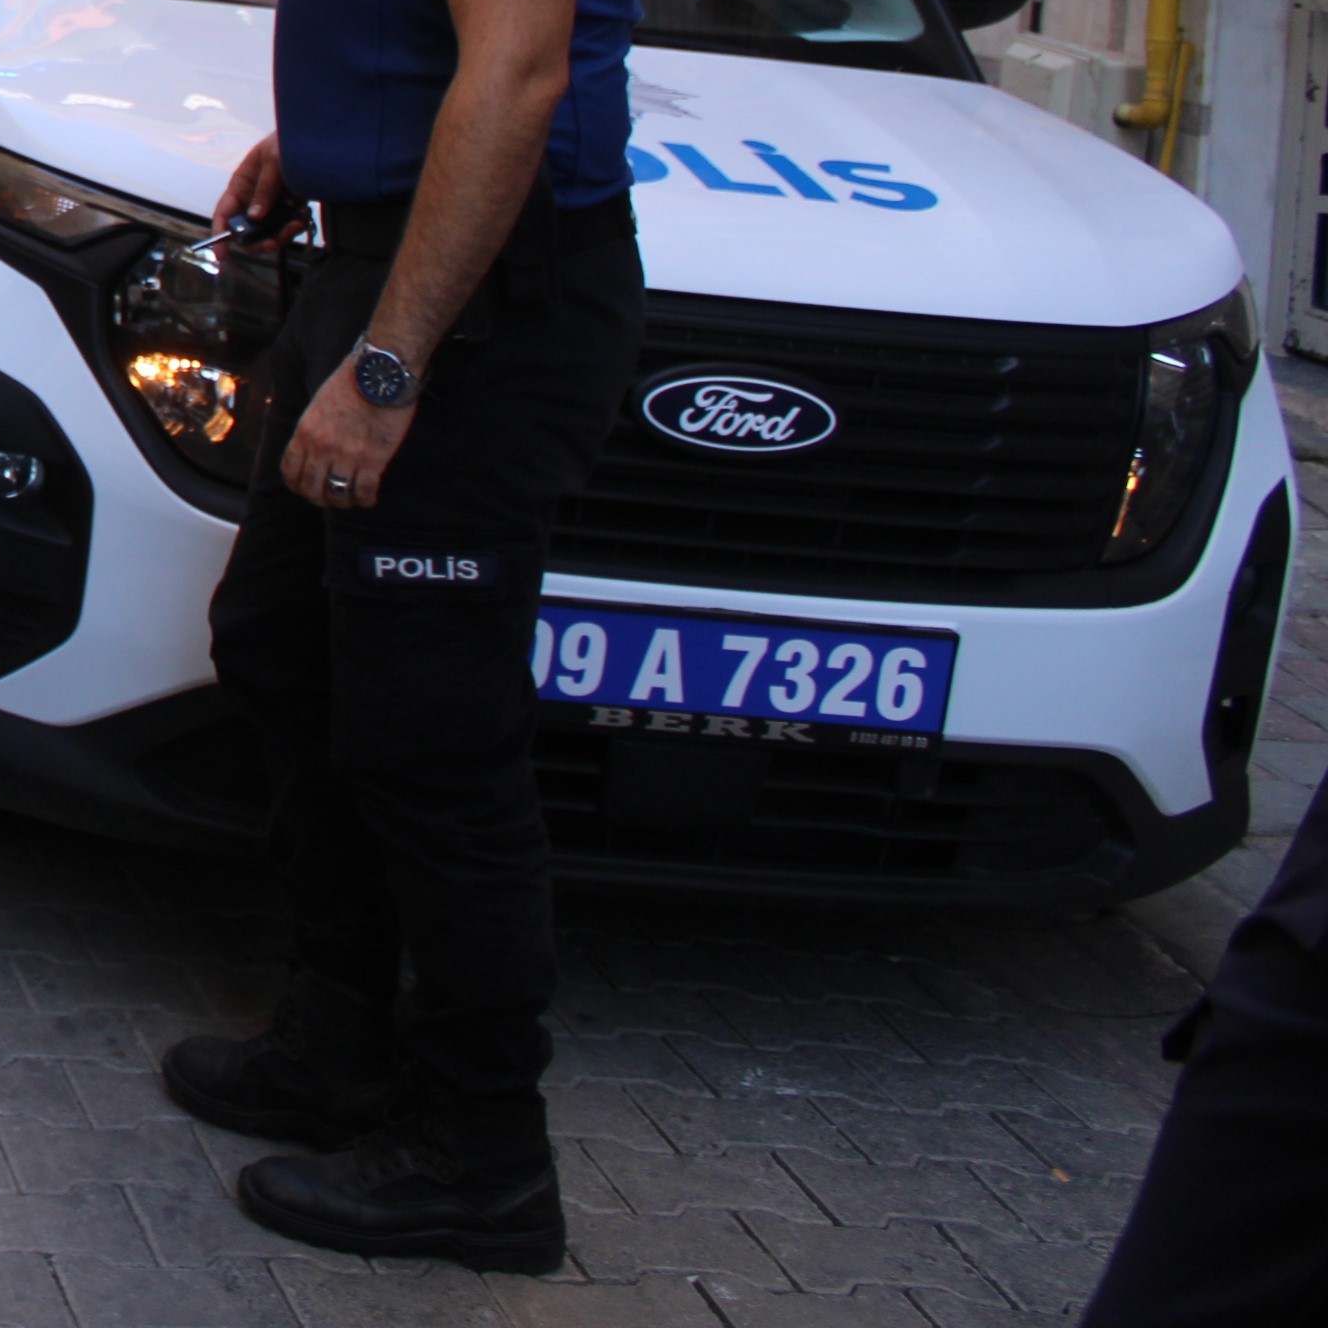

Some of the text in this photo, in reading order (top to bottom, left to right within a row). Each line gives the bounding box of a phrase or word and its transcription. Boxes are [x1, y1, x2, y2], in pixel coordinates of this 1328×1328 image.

[678, 383, 801, 444] Ford
[373, 556, 480, 581] POLİS
[628, 628, 685, 704] A
[721, 633, 928, 723] 7326
[588, 705, 816, 744] BERK
